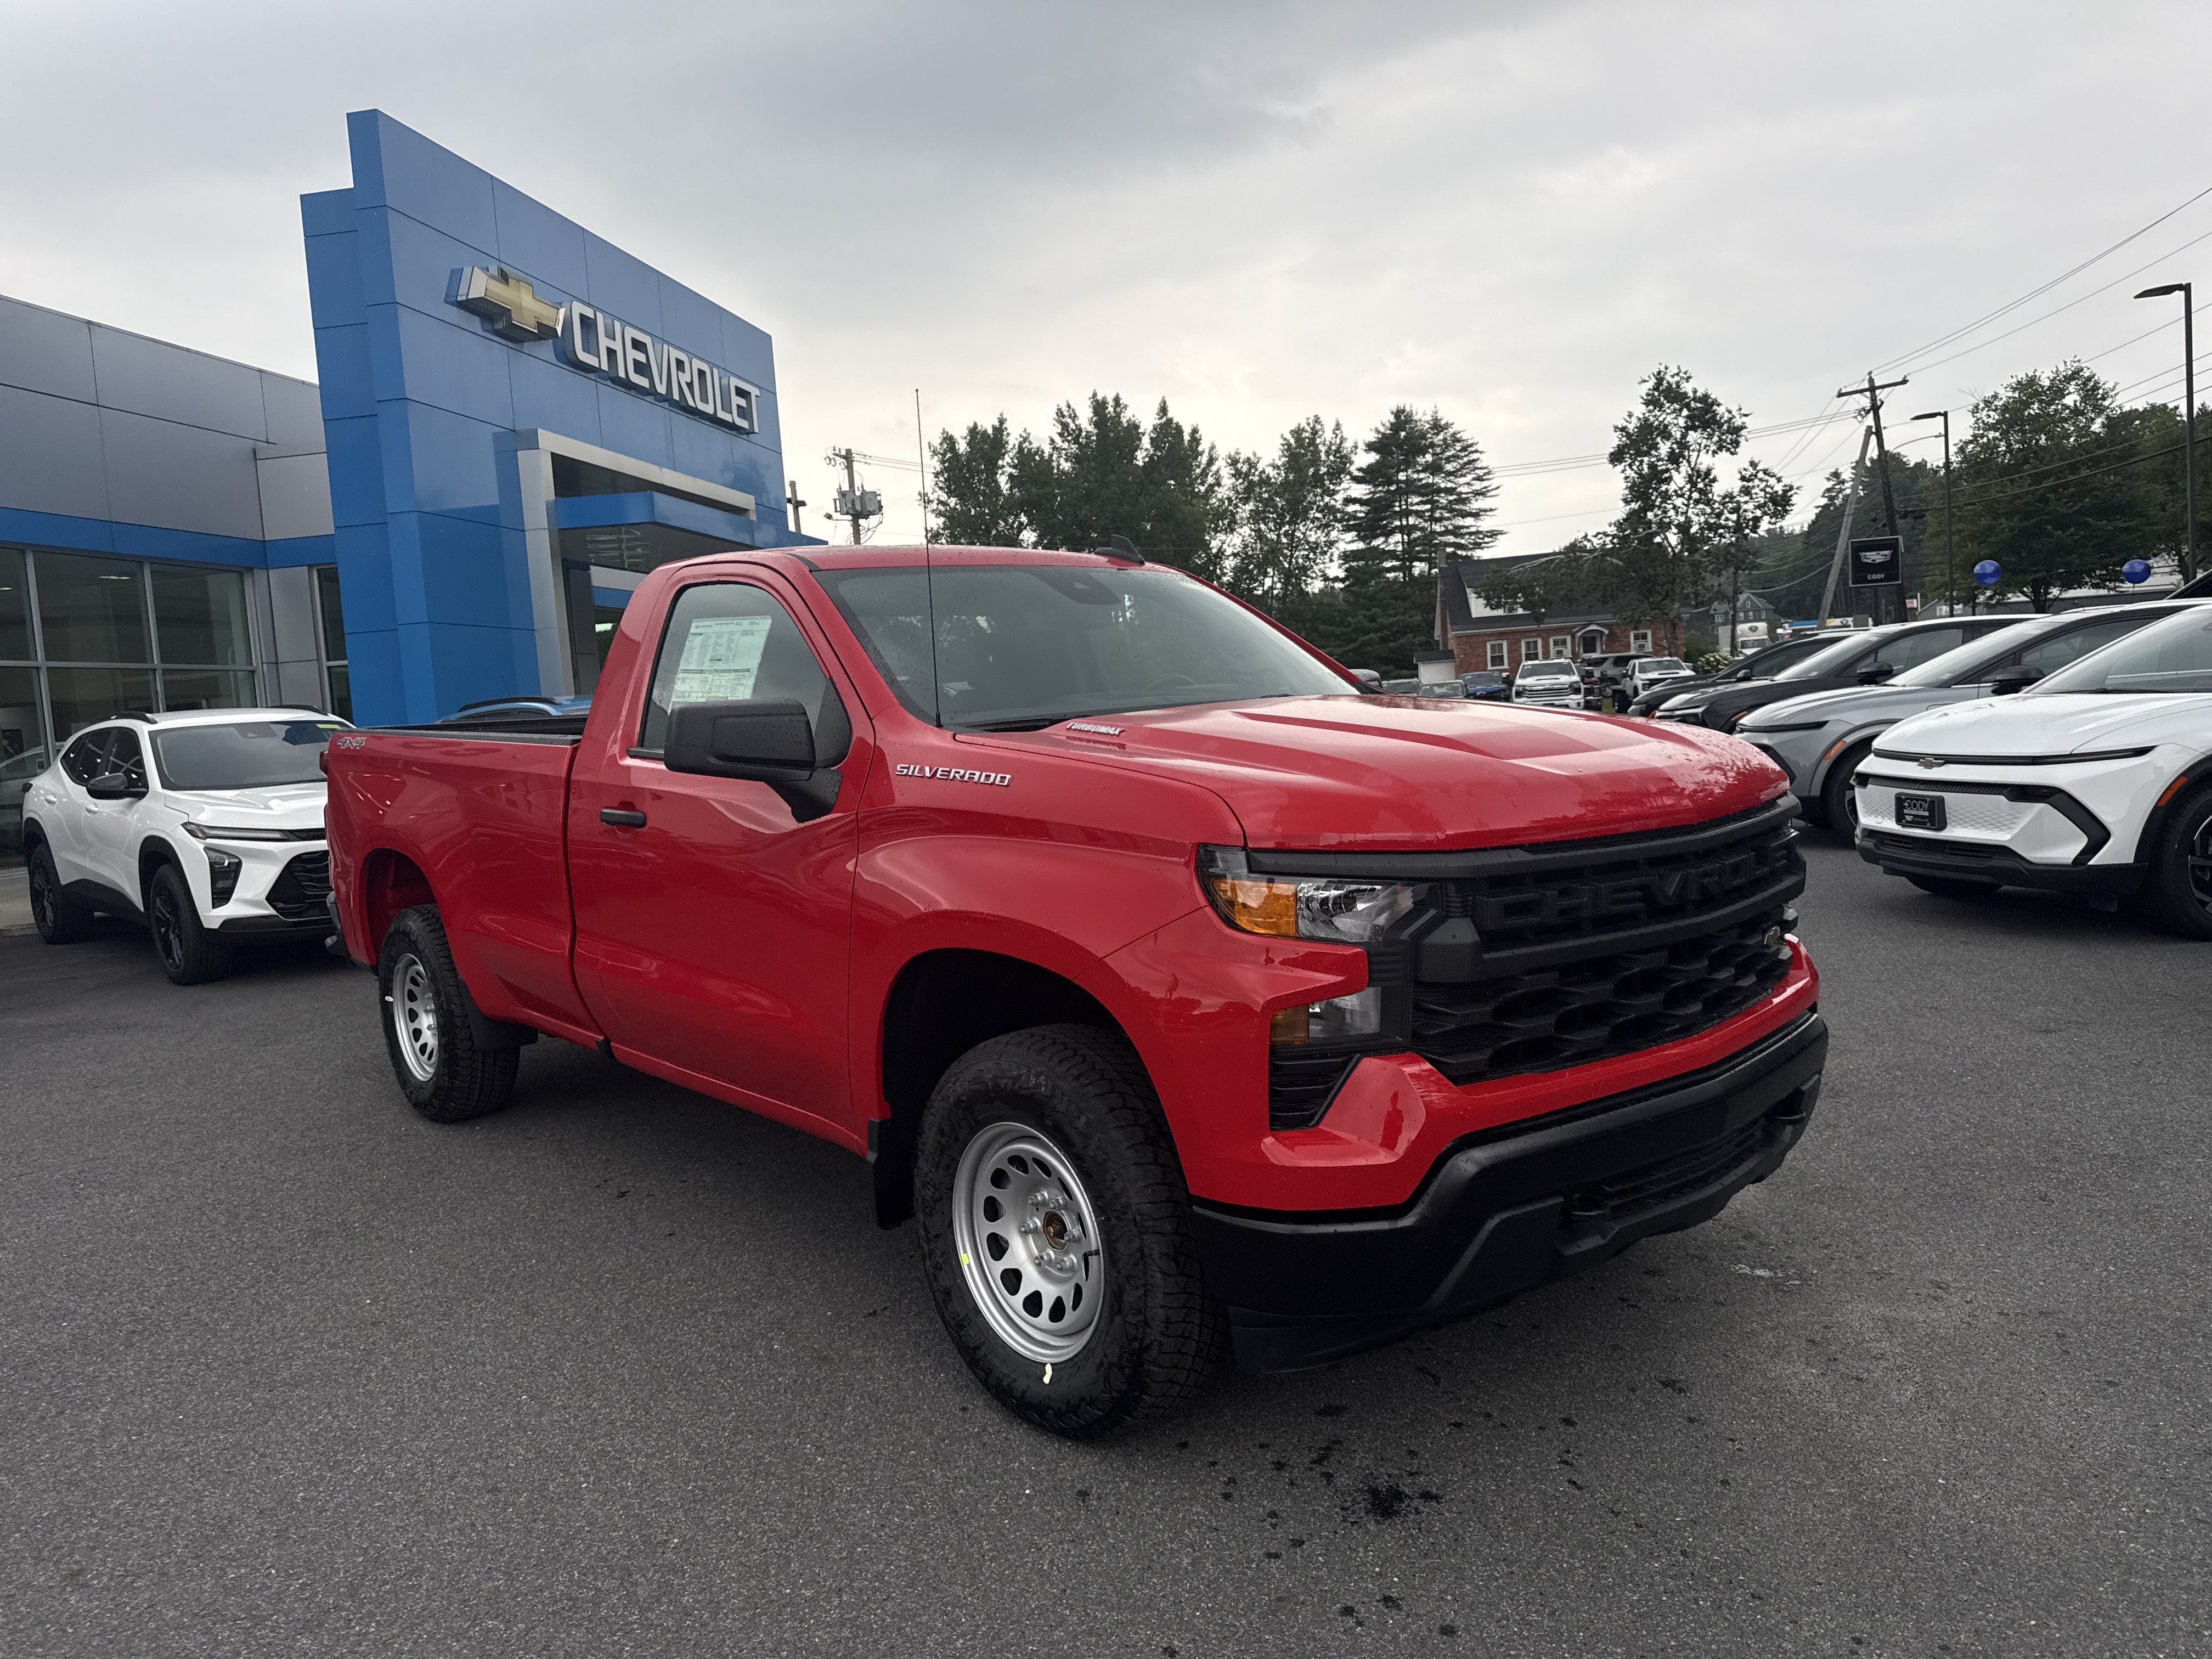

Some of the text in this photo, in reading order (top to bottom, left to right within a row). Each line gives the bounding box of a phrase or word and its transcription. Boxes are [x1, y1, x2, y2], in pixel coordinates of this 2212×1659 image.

[572, 300, 761, 434] CHEVROLET
[1065, 722, 1127, 736] TURBOMAX
[895, 764, 1013, 787] SILVERADO
[1905, 800, 1929, 811] CODY
